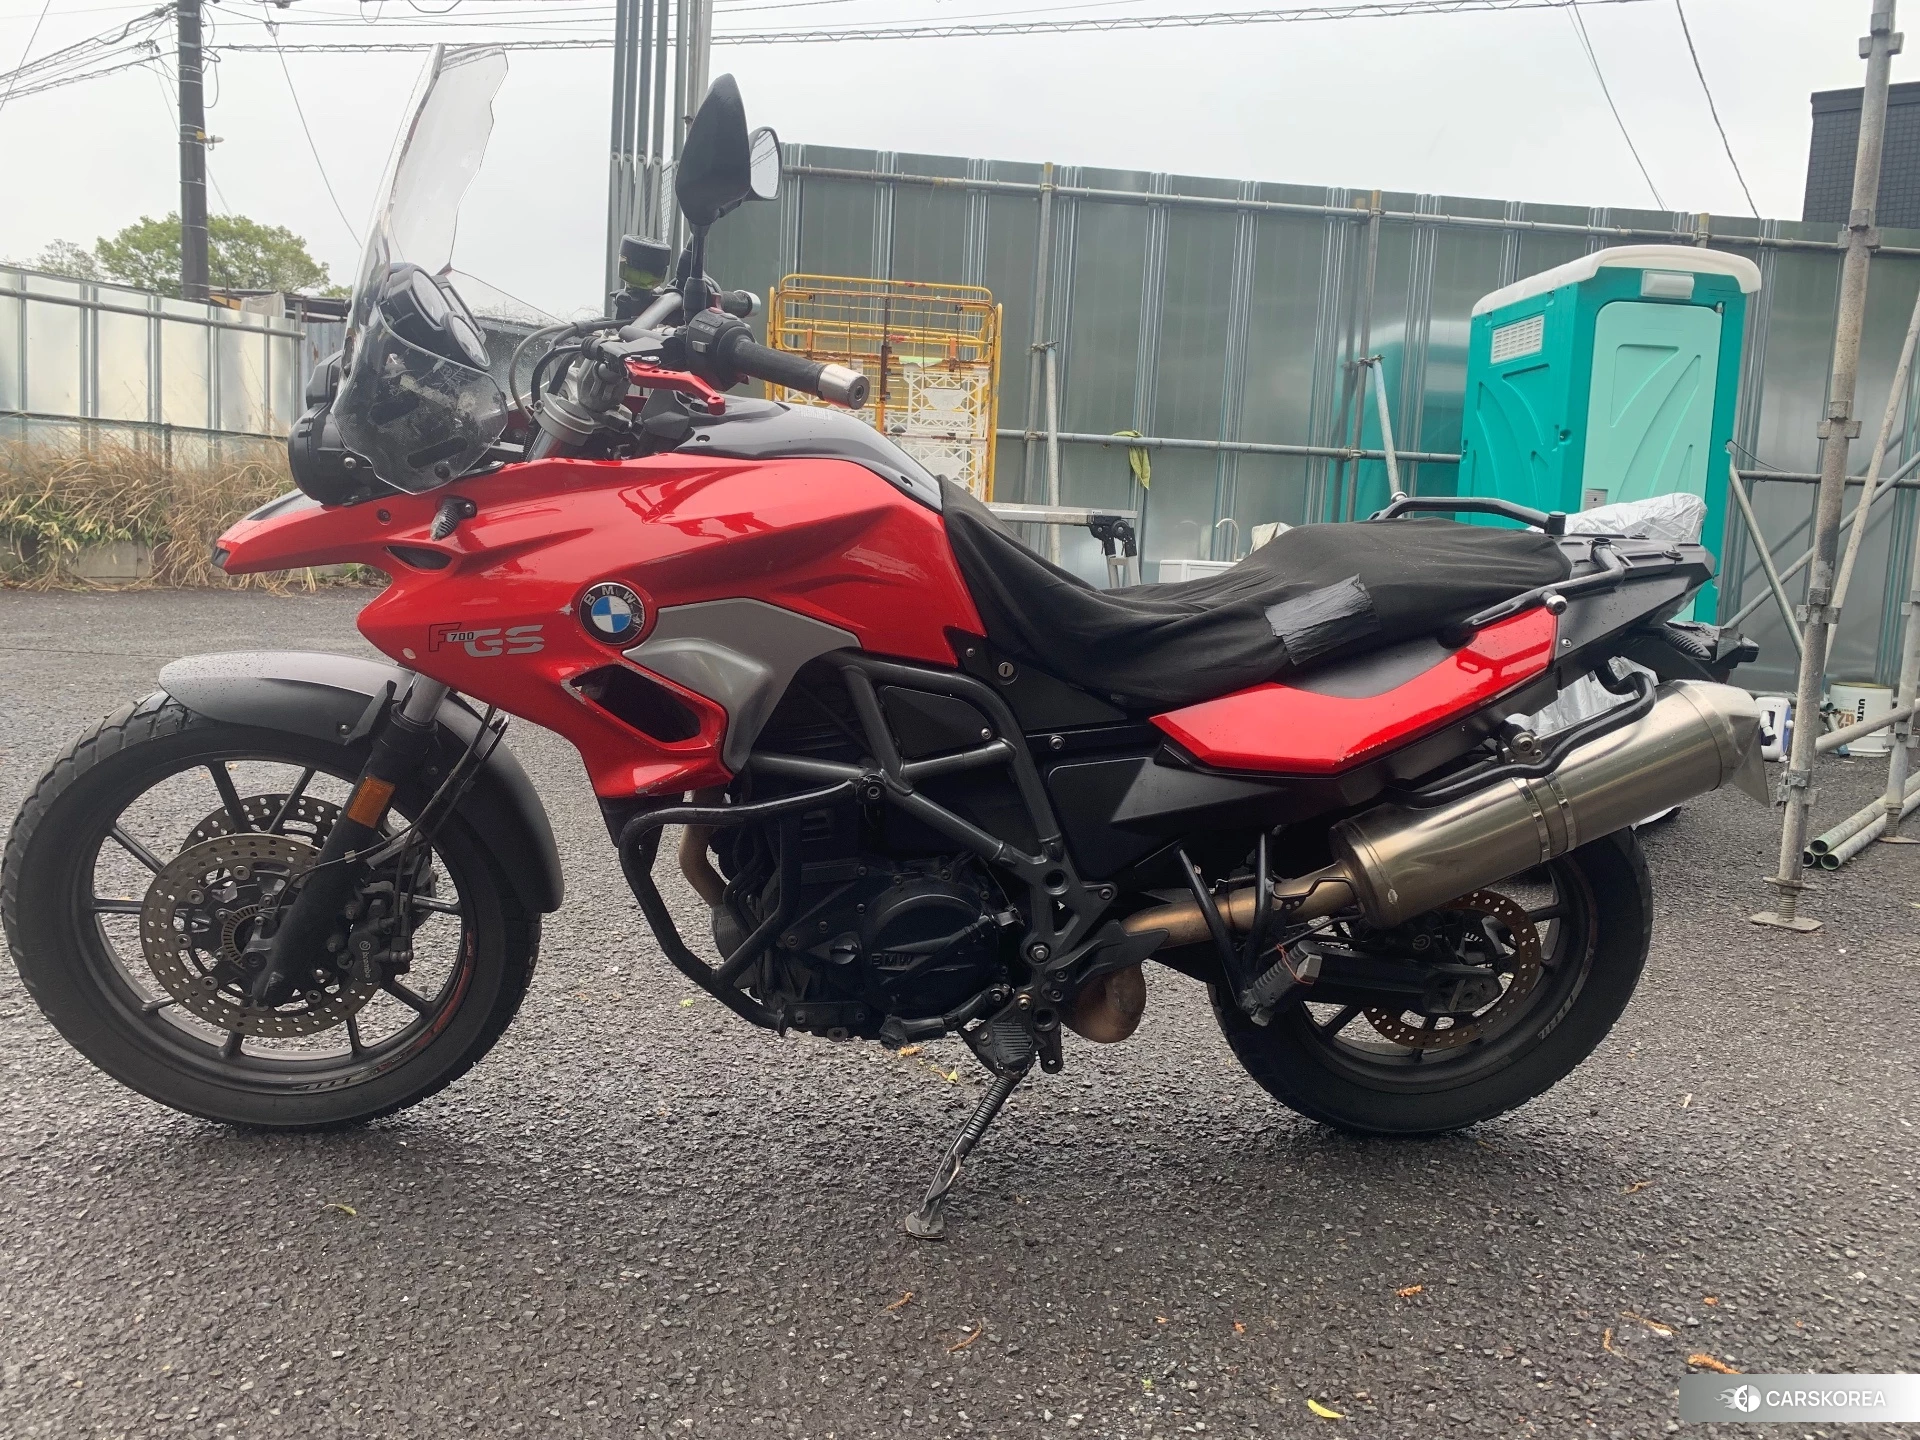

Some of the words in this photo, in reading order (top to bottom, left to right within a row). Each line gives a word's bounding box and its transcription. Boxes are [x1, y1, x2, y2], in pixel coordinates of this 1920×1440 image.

[583, 585, 637, 606] BMW
[450, 632, 475, 642] 700
[464, 626, 545, 658] GS
[362, 951, 372, 979] brembo
[871, 952, 913, 966] BMW
